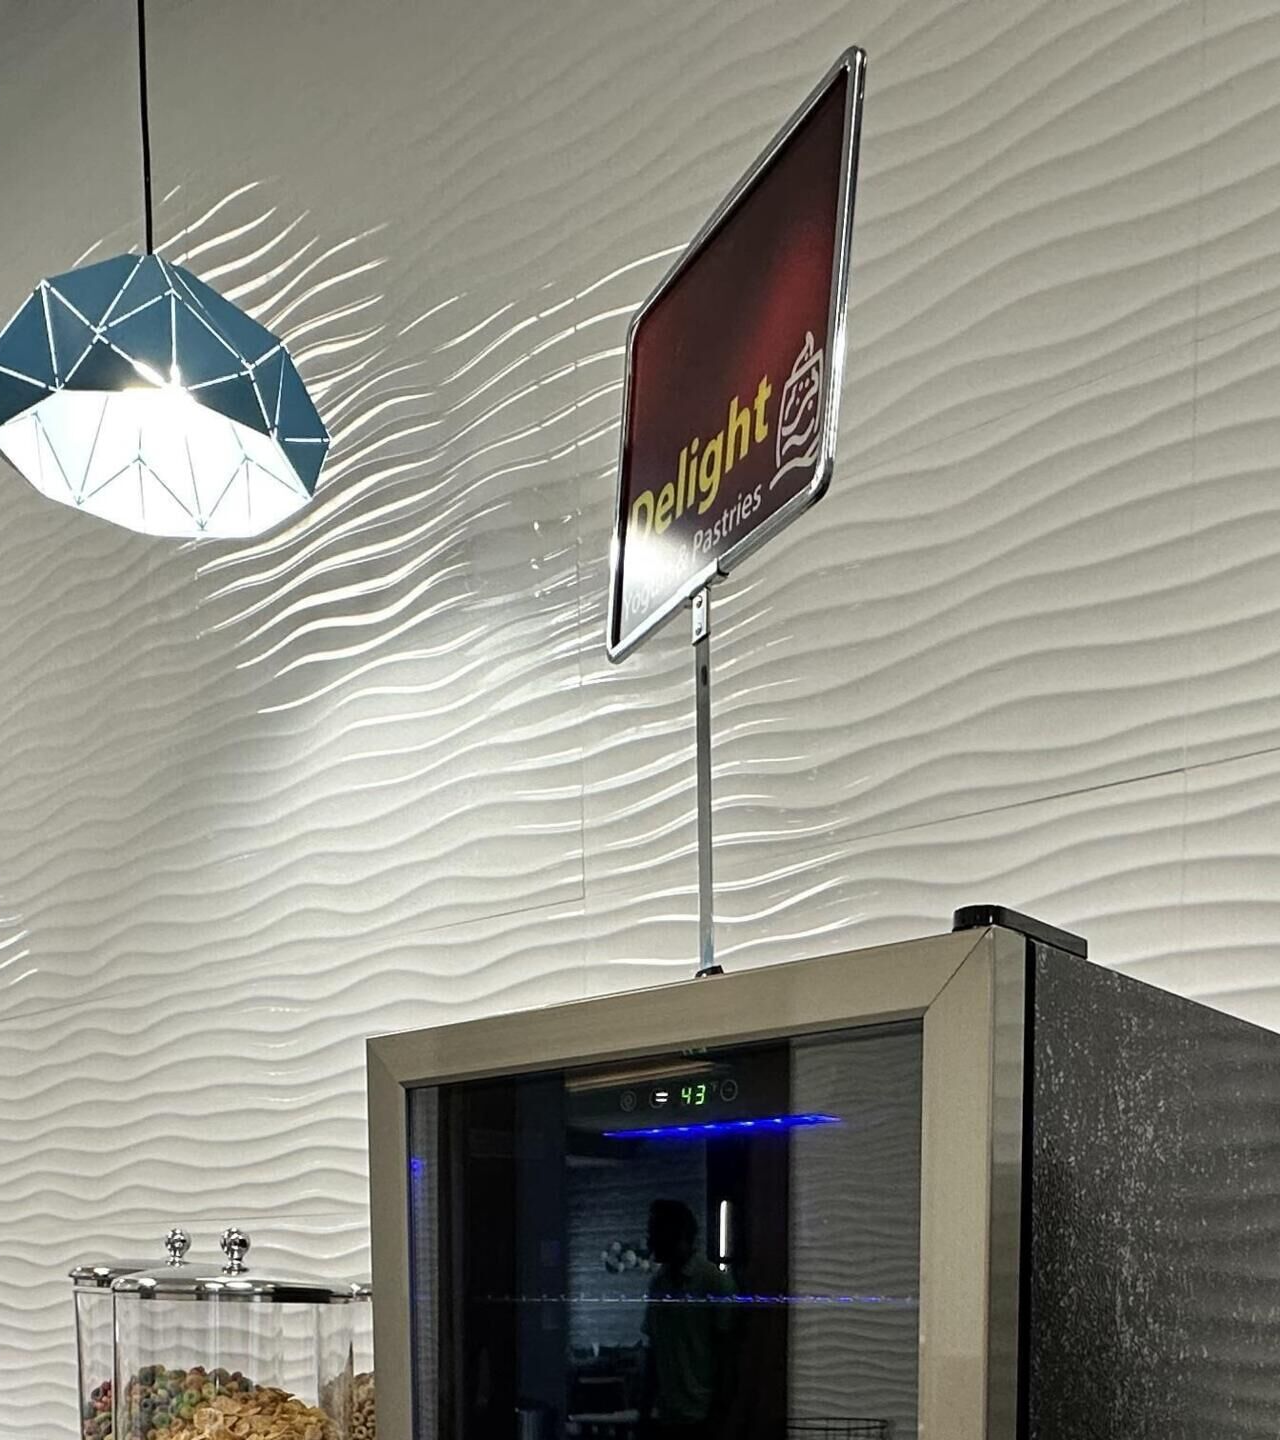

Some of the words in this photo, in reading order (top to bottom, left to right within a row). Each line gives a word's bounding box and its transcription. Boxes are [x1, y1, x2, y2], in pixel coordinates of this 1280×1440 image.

[628, 373, 772, 542] Delight
[693, 484, 762, 560] Pastries
[682, 1084, 706, 1105] 43
